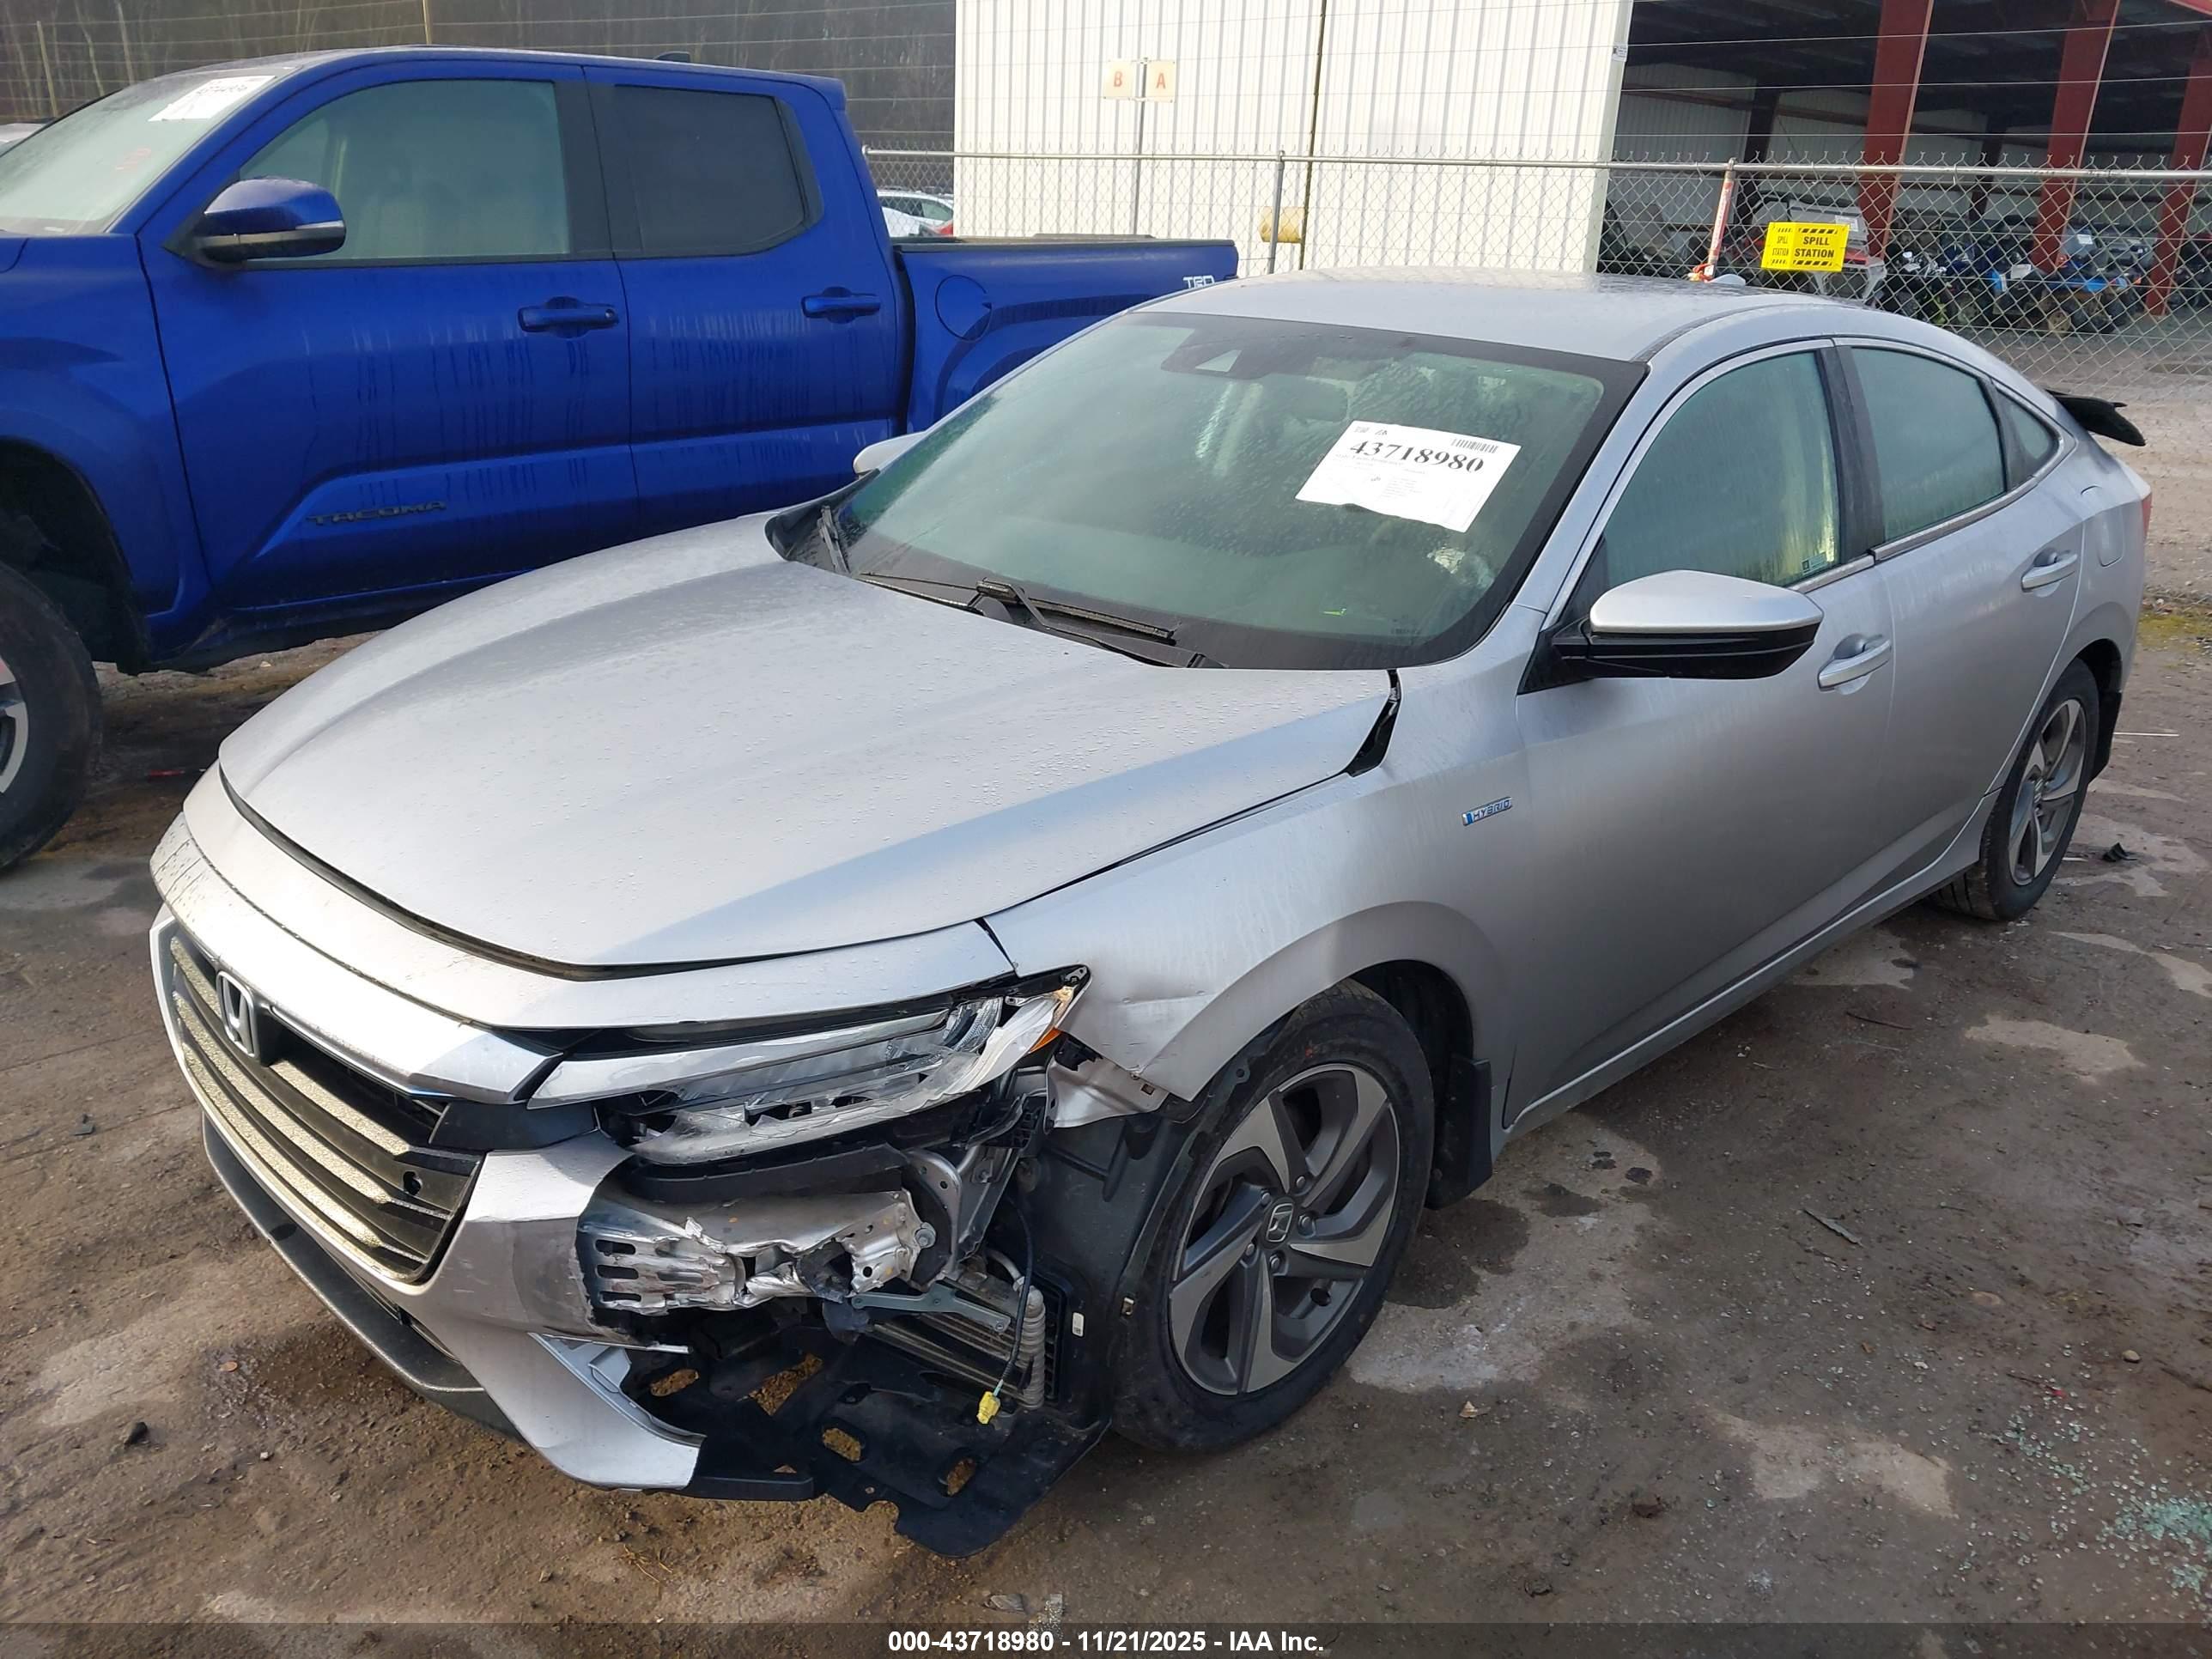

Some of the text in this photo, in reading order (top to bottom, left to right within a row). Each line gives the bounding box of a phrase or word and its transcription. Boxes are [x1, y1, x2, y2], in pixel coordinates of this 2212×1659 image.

[1113, 70, 1123, 88] B
[1156, 72, 1166, 89] A
[1802, 236, 1830, 246] SPILL
[1794, 247, 1835, 258] STATION
[1182, 274, 1216, 289] TRD
[1349, 440, 1485, 473] 43718980
[306, 501, 447, 526] TACOMA
[1473, 799, 1510, 821] HYBRID
